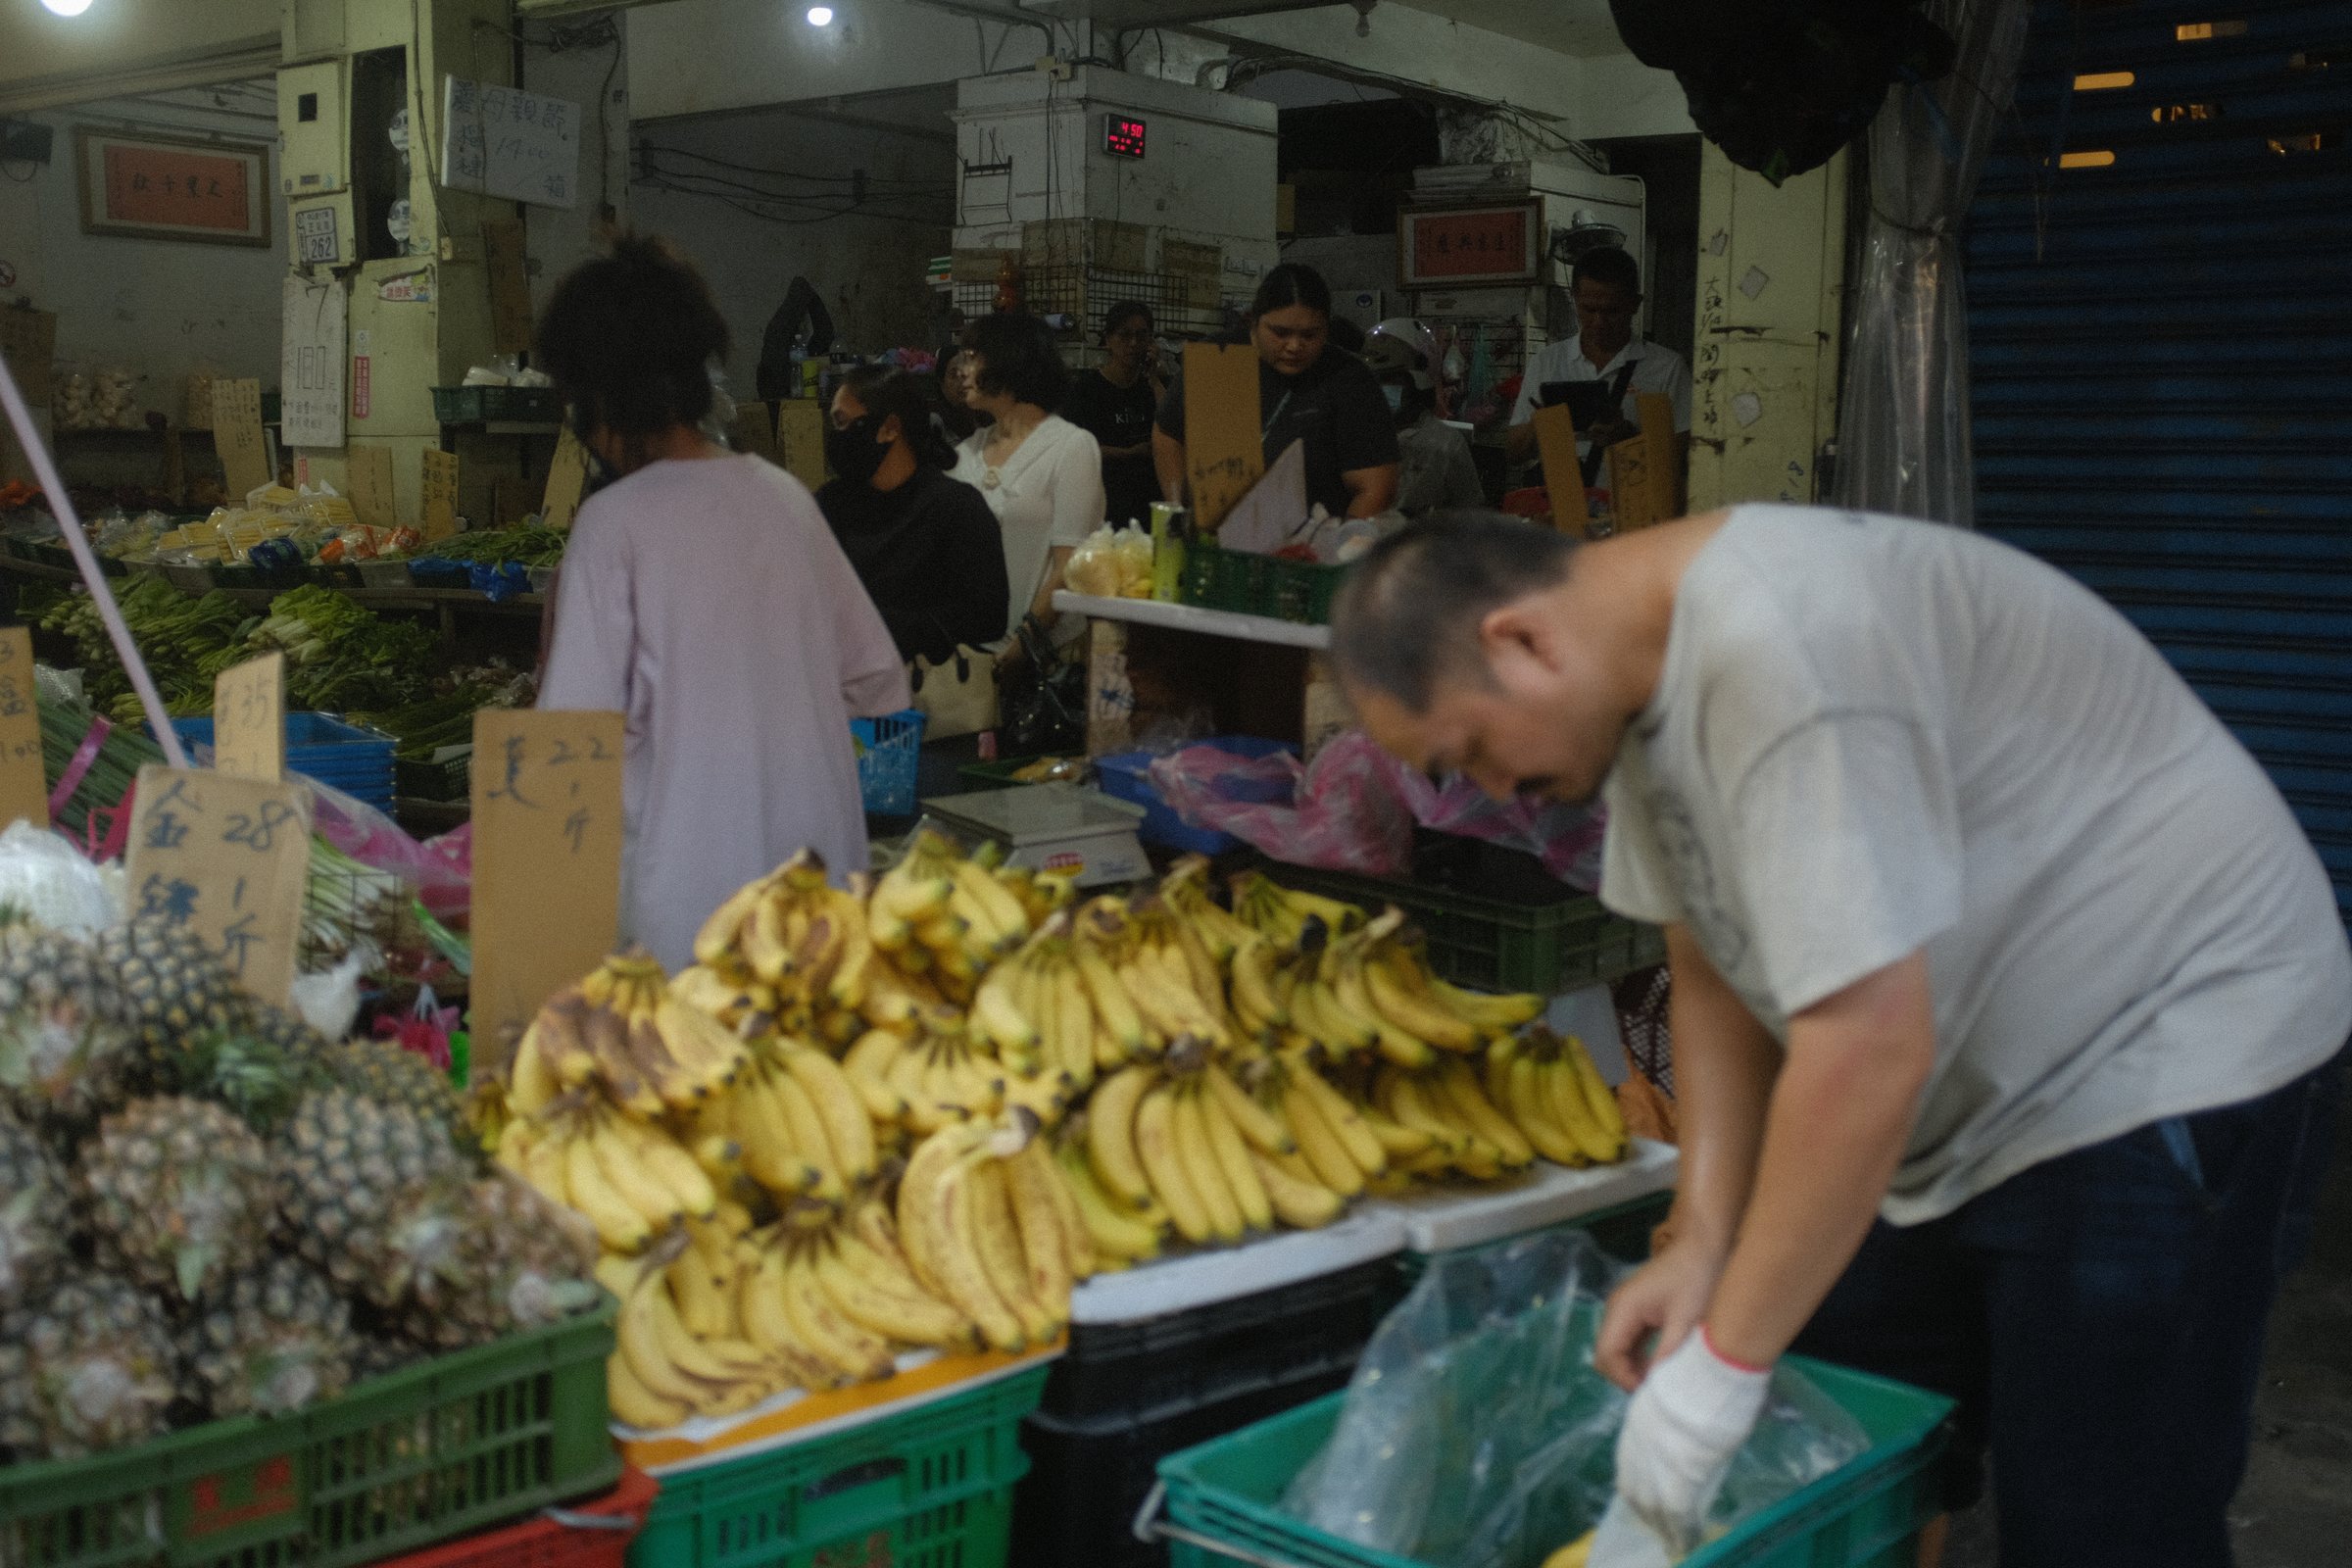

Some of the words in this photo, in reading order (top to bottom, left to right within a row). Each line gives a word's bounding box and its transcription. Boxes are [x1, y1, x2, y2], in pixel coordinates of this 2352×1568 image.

[311, 236, 332, 259] 262
[547, 735, 616, 764] 22
[223, 799, 295, 852] 28
